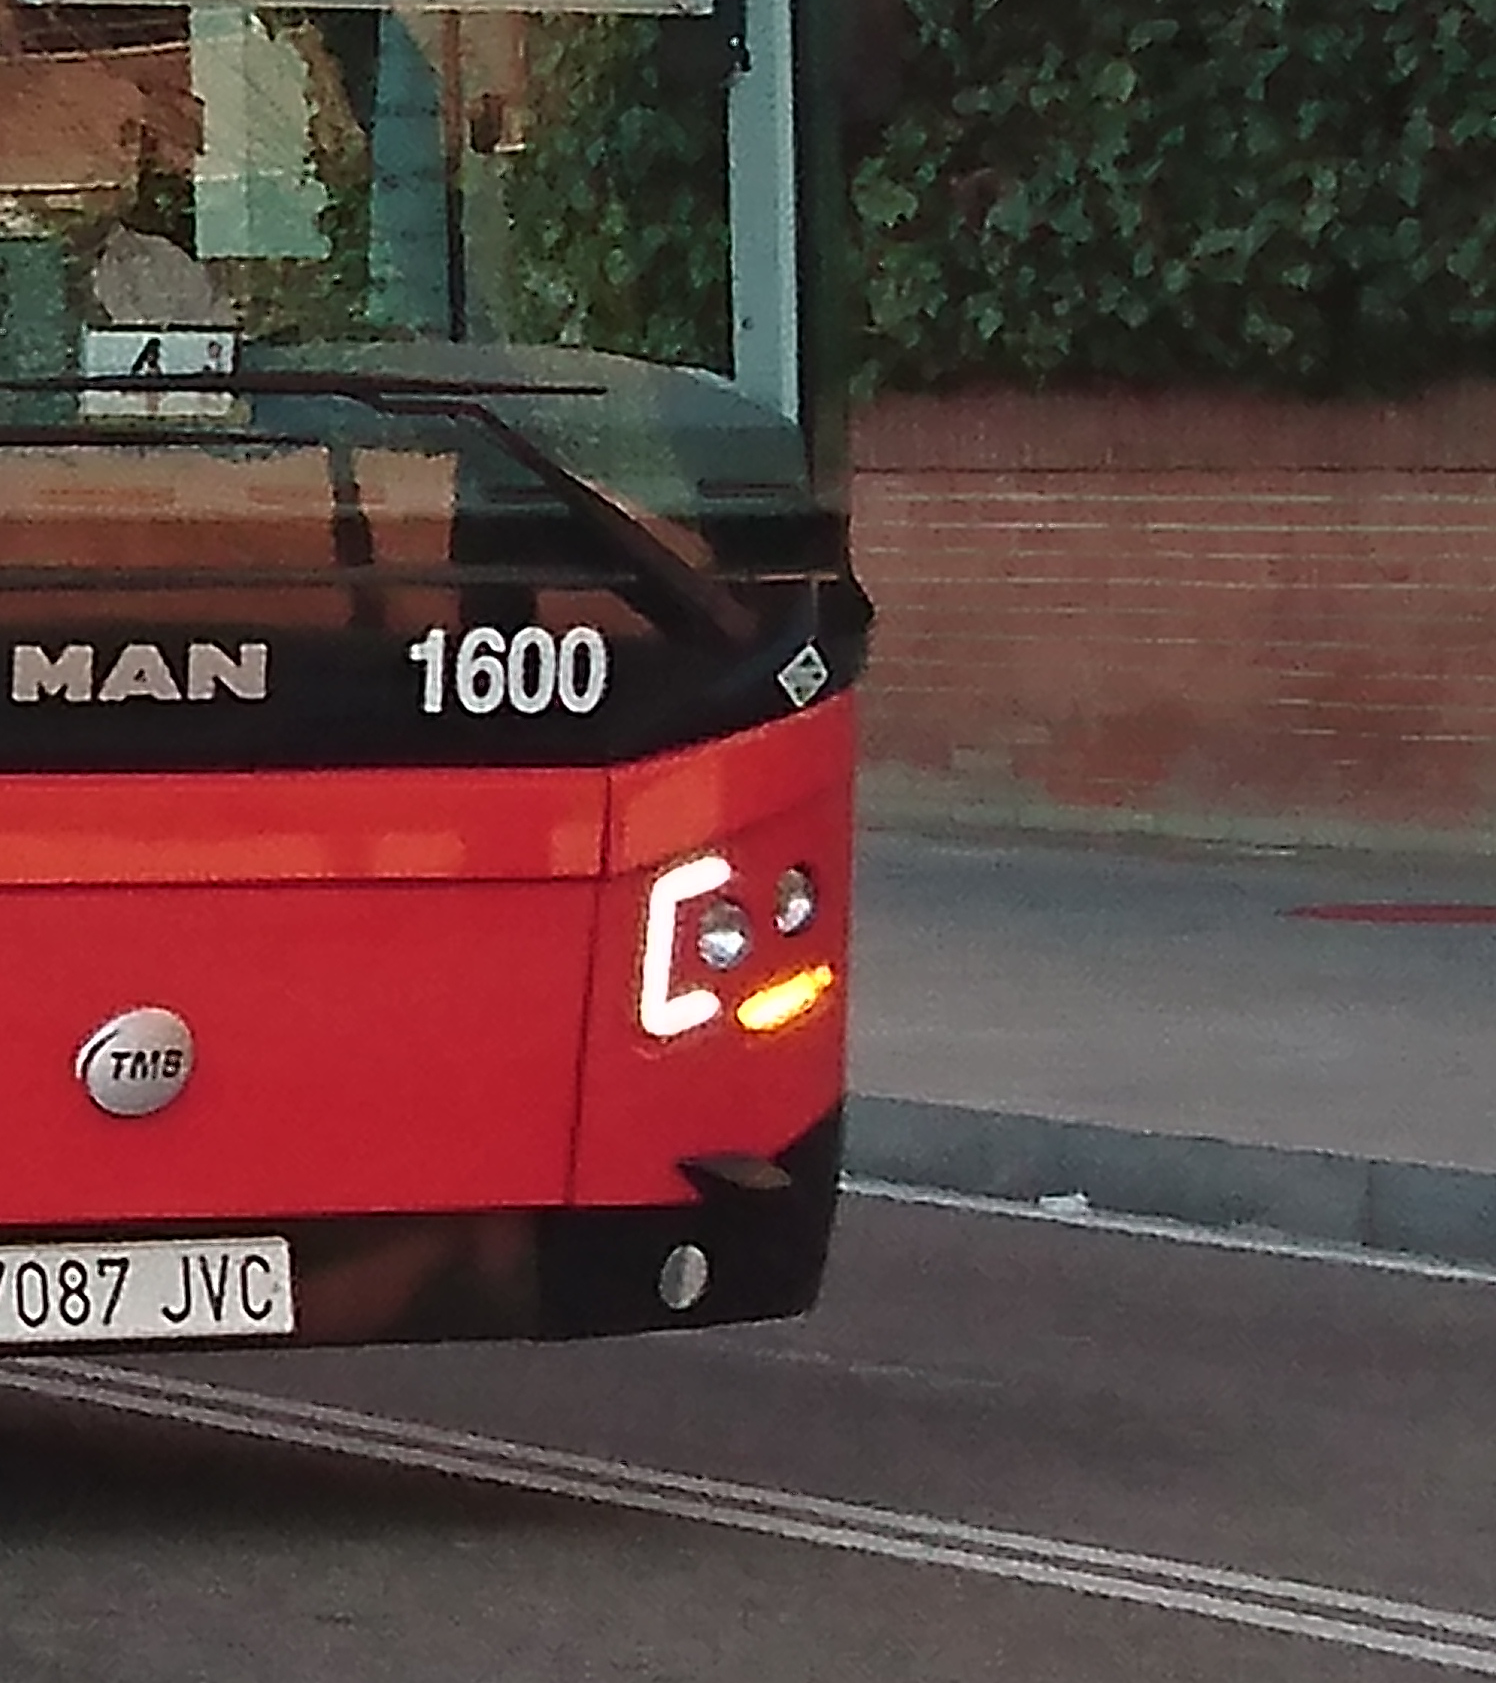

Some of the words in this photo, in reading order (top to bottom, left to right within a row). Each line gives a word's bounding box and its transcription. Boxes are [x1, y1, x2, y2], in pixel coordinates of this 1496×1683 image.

[11, 644, 268, 701] MAN
[409, 626, 608, 714] 1600
[110, 1048, 183, 1081] TMB
[161, 1254, 273, 1323] JVC
